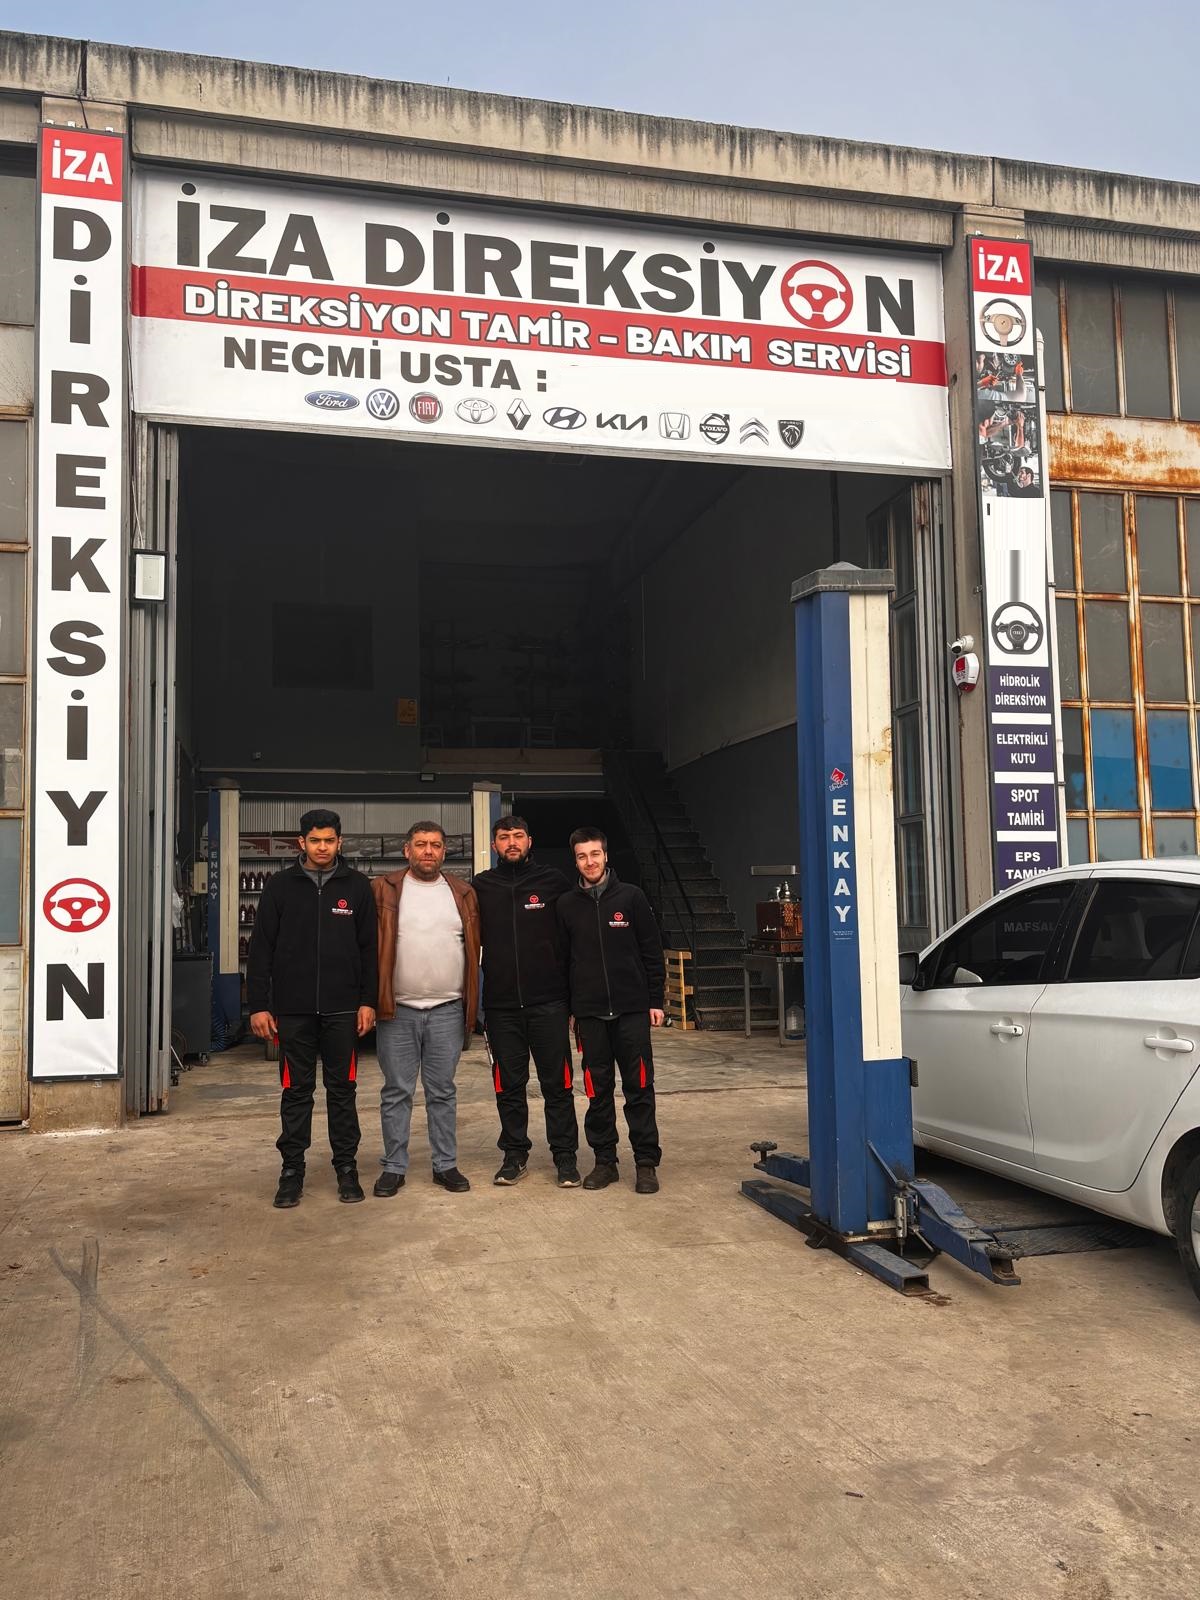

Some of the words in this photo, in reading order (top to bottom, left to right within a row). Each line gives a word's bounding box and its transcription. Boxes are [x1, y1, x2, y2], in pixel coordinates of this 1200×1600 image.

[52, 139, 113, 185] İZA
[177, 182, 334, 280] İZA
[978, 246, 1023, 283] İZA
[184, 280, 452, 338] DİREKSİYON
[461, 310, 591, 350] TAMİR
[626, 325, 751, 363] BAKIM
[768, 340, 911, 377] SERVİSİ
[224, 337, 381, 380] NECMİ
[400, 351, 521, 391] USTA
[418, 401, 435, 415] FIAT
[1000, 674, 1040, 687] HİDROLİK
[995, 691, 1046, 706] DİREKSİYON
[996, 731, 1048, 746] ELEKTRİKLİ
[1010, 752, 1036, 764] KUTU
[1011, 789, 1039, 802] SPOT
[1007, 809, 1045, 826] TAMİRİ
[832, 798, 851, 923] ENKAY
[1016, 852, 1041, 862] EPS
[210, 851, 218, 900] ENKAY
[1005, 867, 1051, 880] TAMİ
